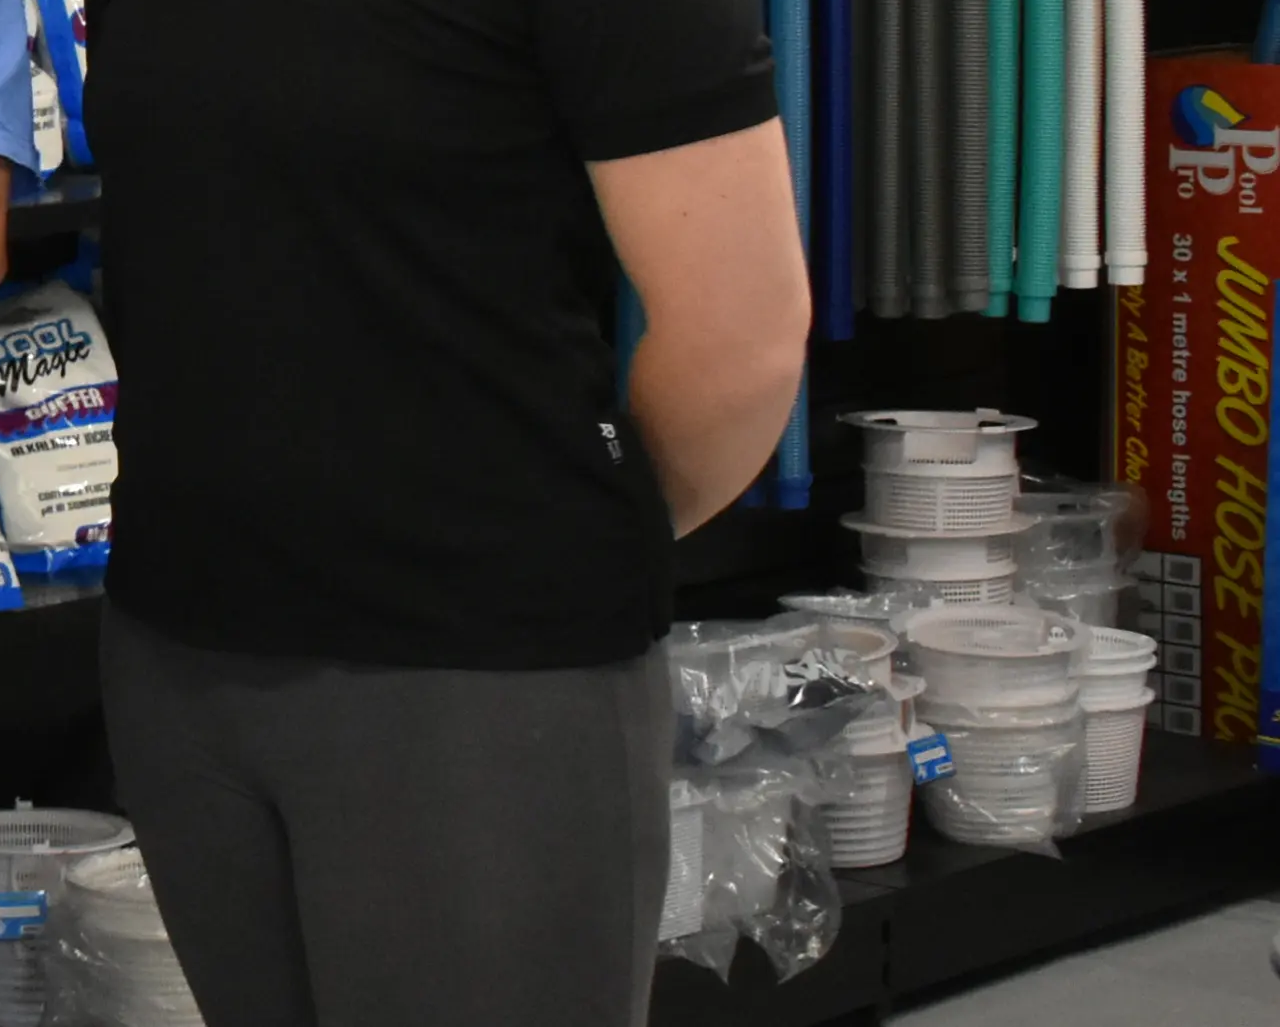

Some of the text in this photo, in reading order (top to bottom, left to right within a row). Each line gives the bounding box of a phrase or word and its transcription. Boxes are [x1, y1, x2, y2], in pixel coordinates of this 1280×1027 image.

[1169, 143, 1237, 200] Pro
[1214, 124, 1280, 214] Pool
[25, 387, 105, 421] BUFFER
[1126, 347, 1149, 432] Better
[1167, 233, 1193, 541] 30 x 1 metre hose lengths
[1125, 436, 1149, 484] Cho
[1213, 235, 1270, 742] JUMBO HOSE PAC
